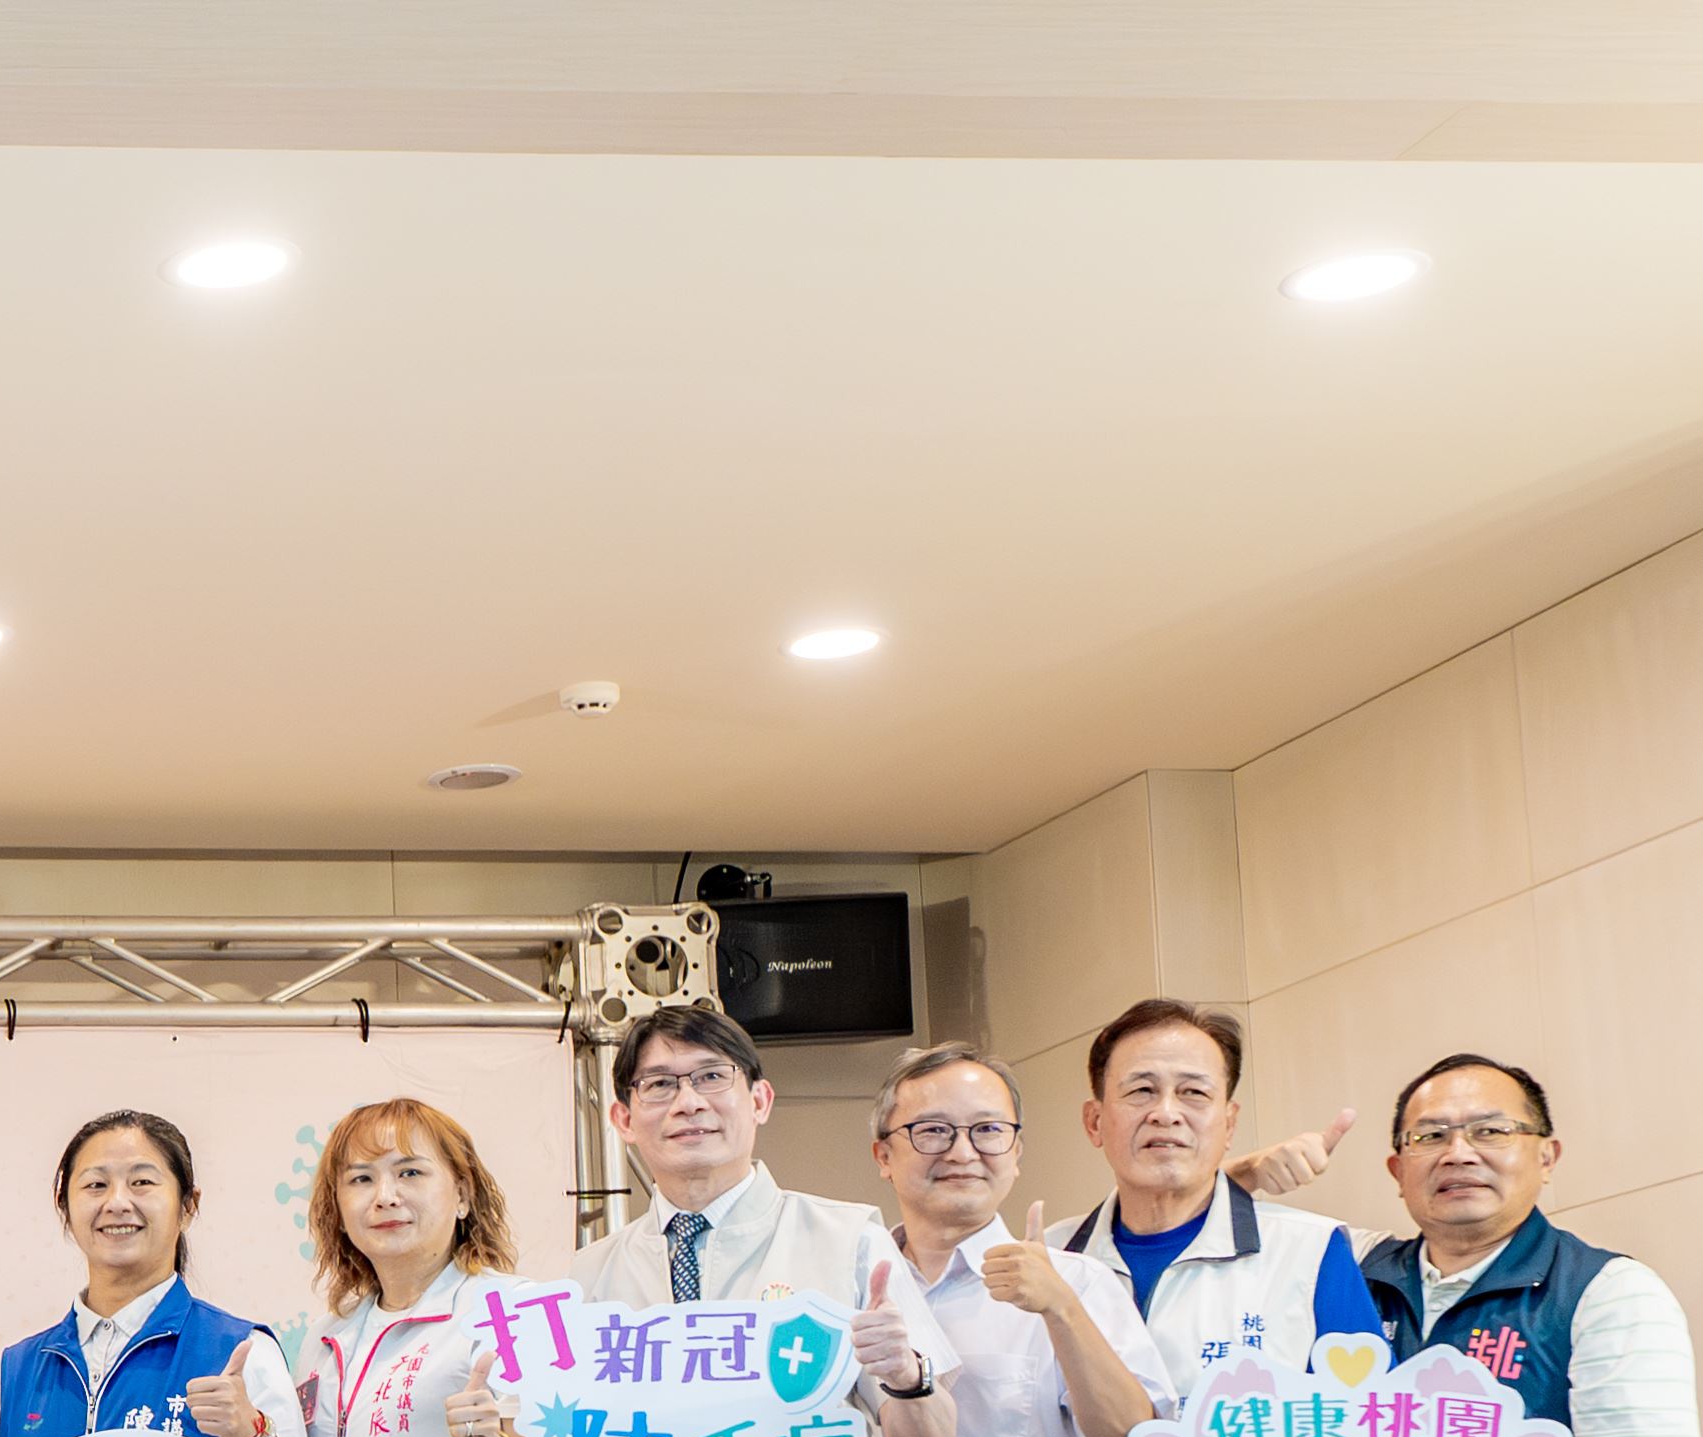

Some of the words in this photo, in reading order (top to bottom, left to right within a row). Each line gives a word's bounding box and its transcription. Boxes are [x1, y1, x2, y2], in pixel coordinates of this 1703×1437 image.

[767, 958, 833, 974] Napoleon
[474, 1290, 761, 1384] 打新冠
